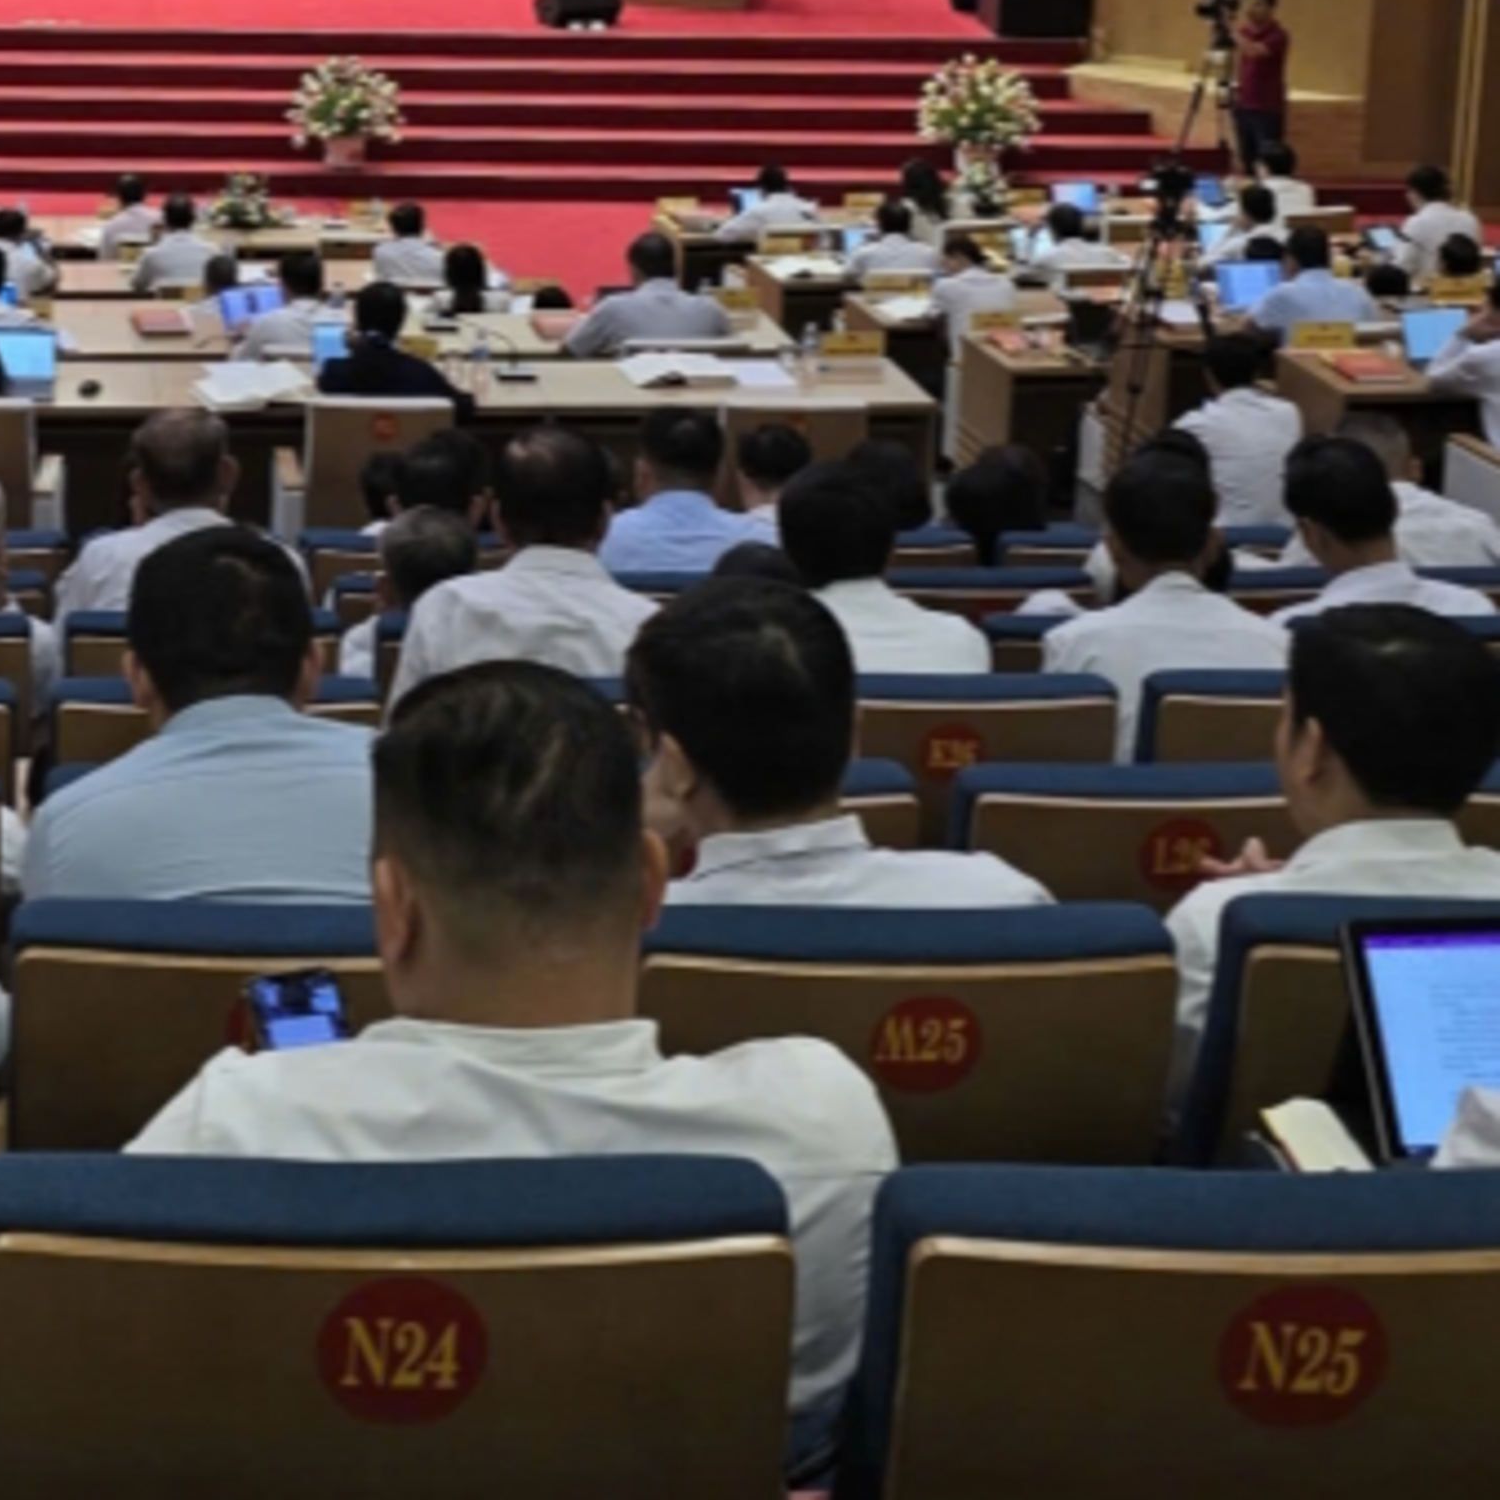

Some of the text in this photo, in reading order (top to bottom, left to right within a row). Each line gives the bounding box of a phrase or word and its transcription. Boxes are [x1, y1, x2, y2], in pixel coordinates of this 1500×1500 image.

[874, 1016, 968, 1063] M25
[340, 1317, 461, 1389] N24
[1237, 1322, 1369, 1396] N25
